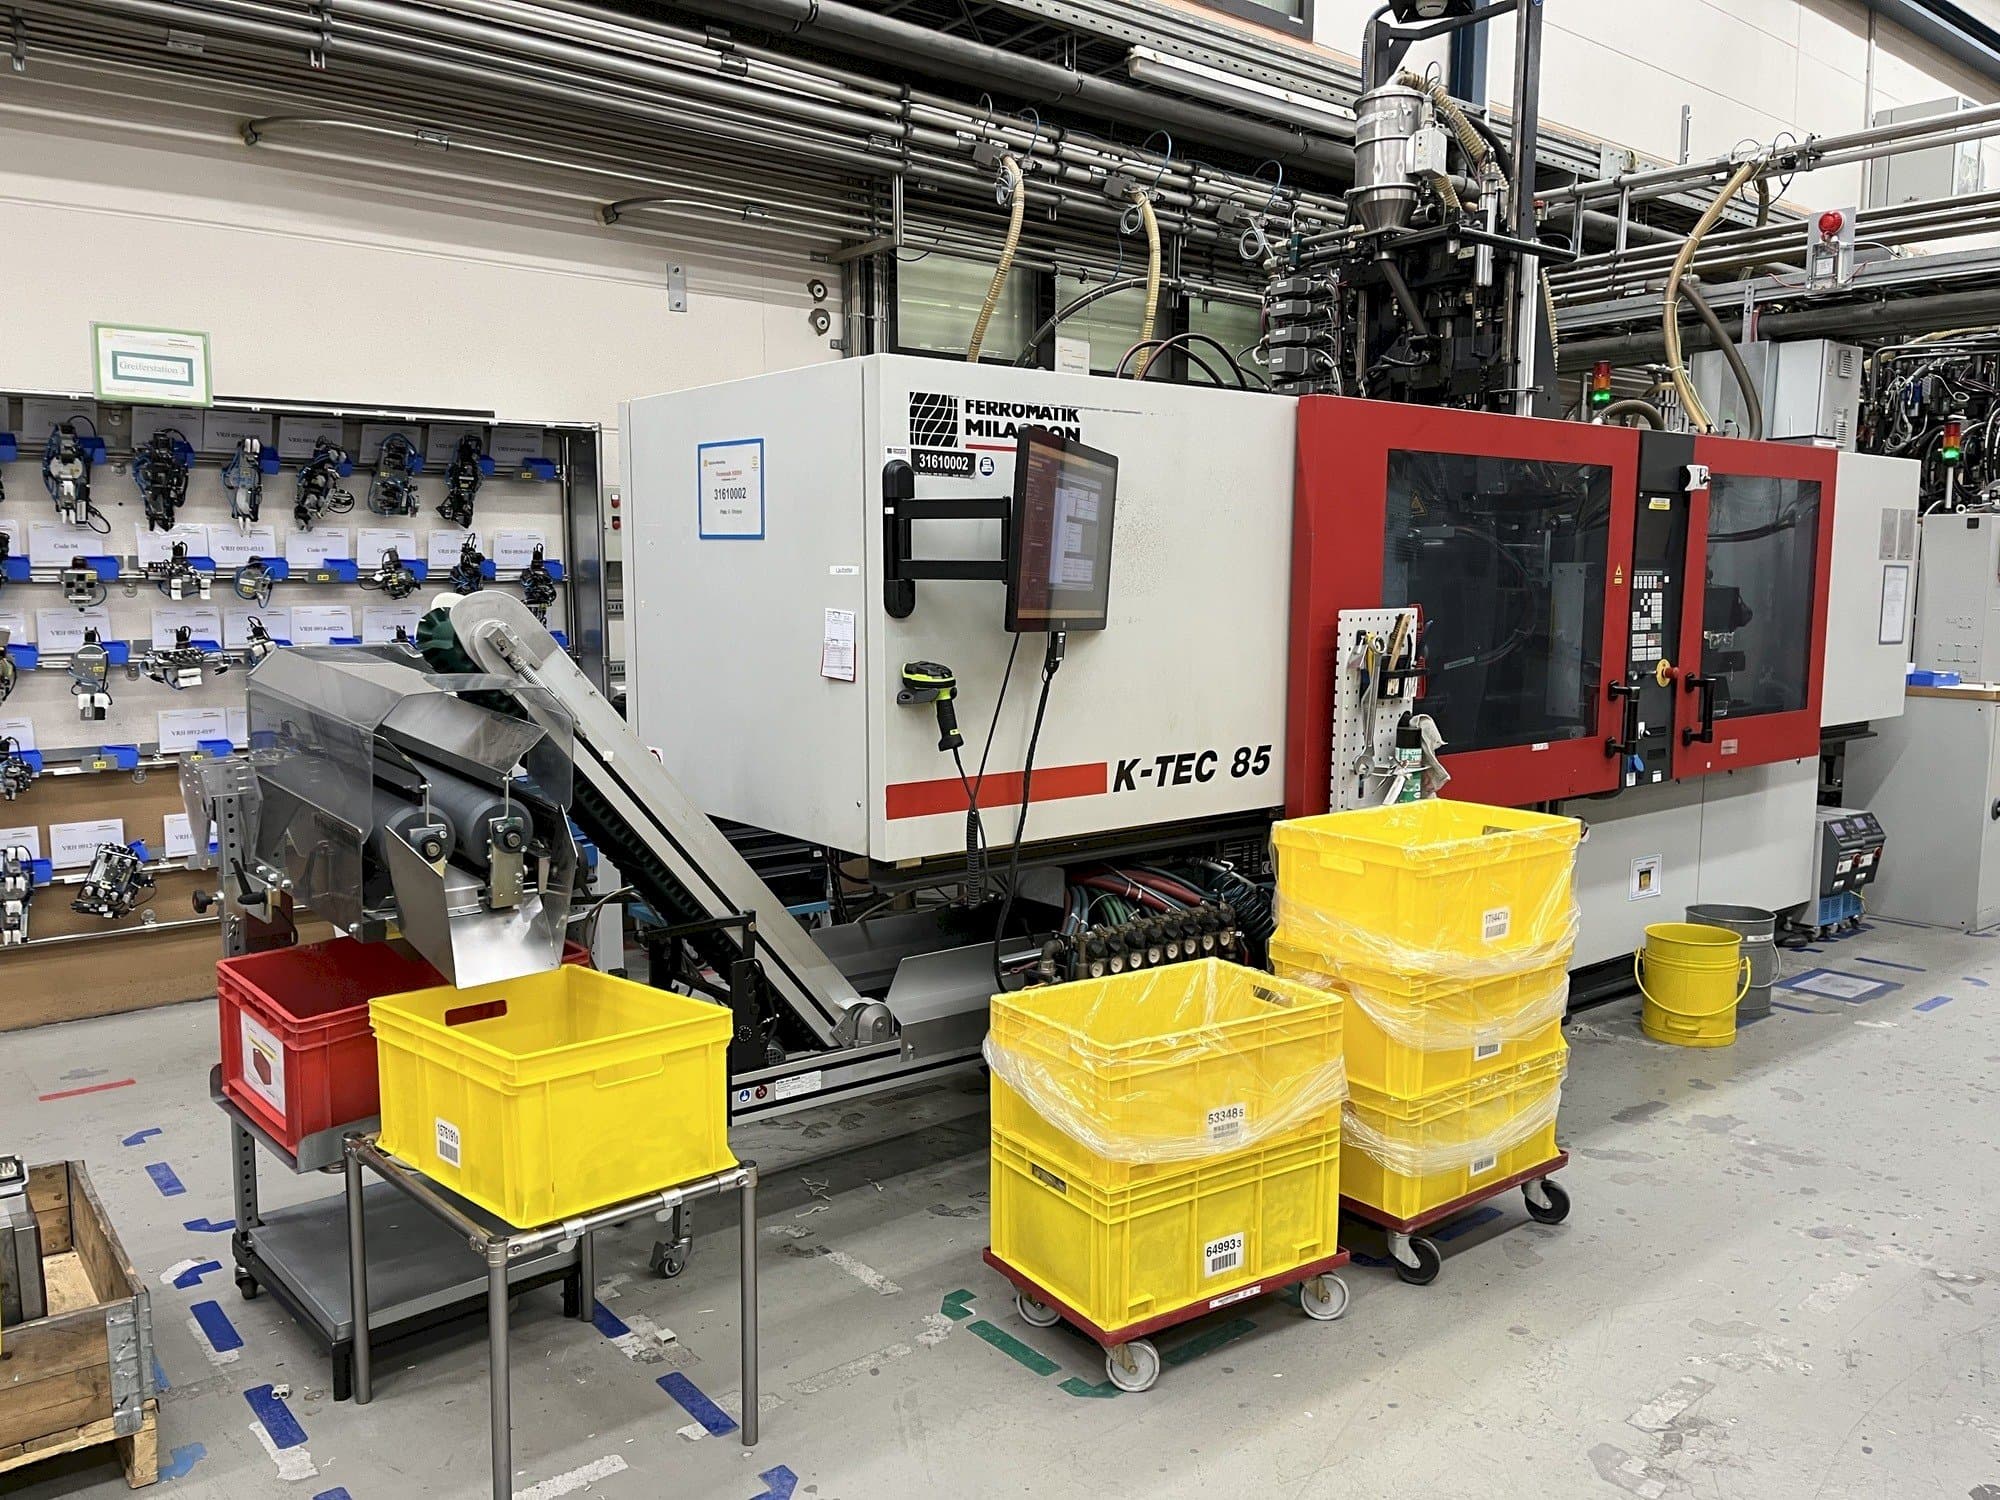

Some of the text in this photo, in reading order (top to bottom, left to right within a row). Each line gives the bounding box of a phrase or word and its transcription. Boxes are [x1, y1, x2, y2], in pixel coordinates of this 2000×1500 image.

[965, 399, 1080, 423] FERROMATIK
[919, 453, 969, 471] 31610002
[714, 487, 747, 500] 31610002
[1112, 744, 1273, 793] K-TEC 85
